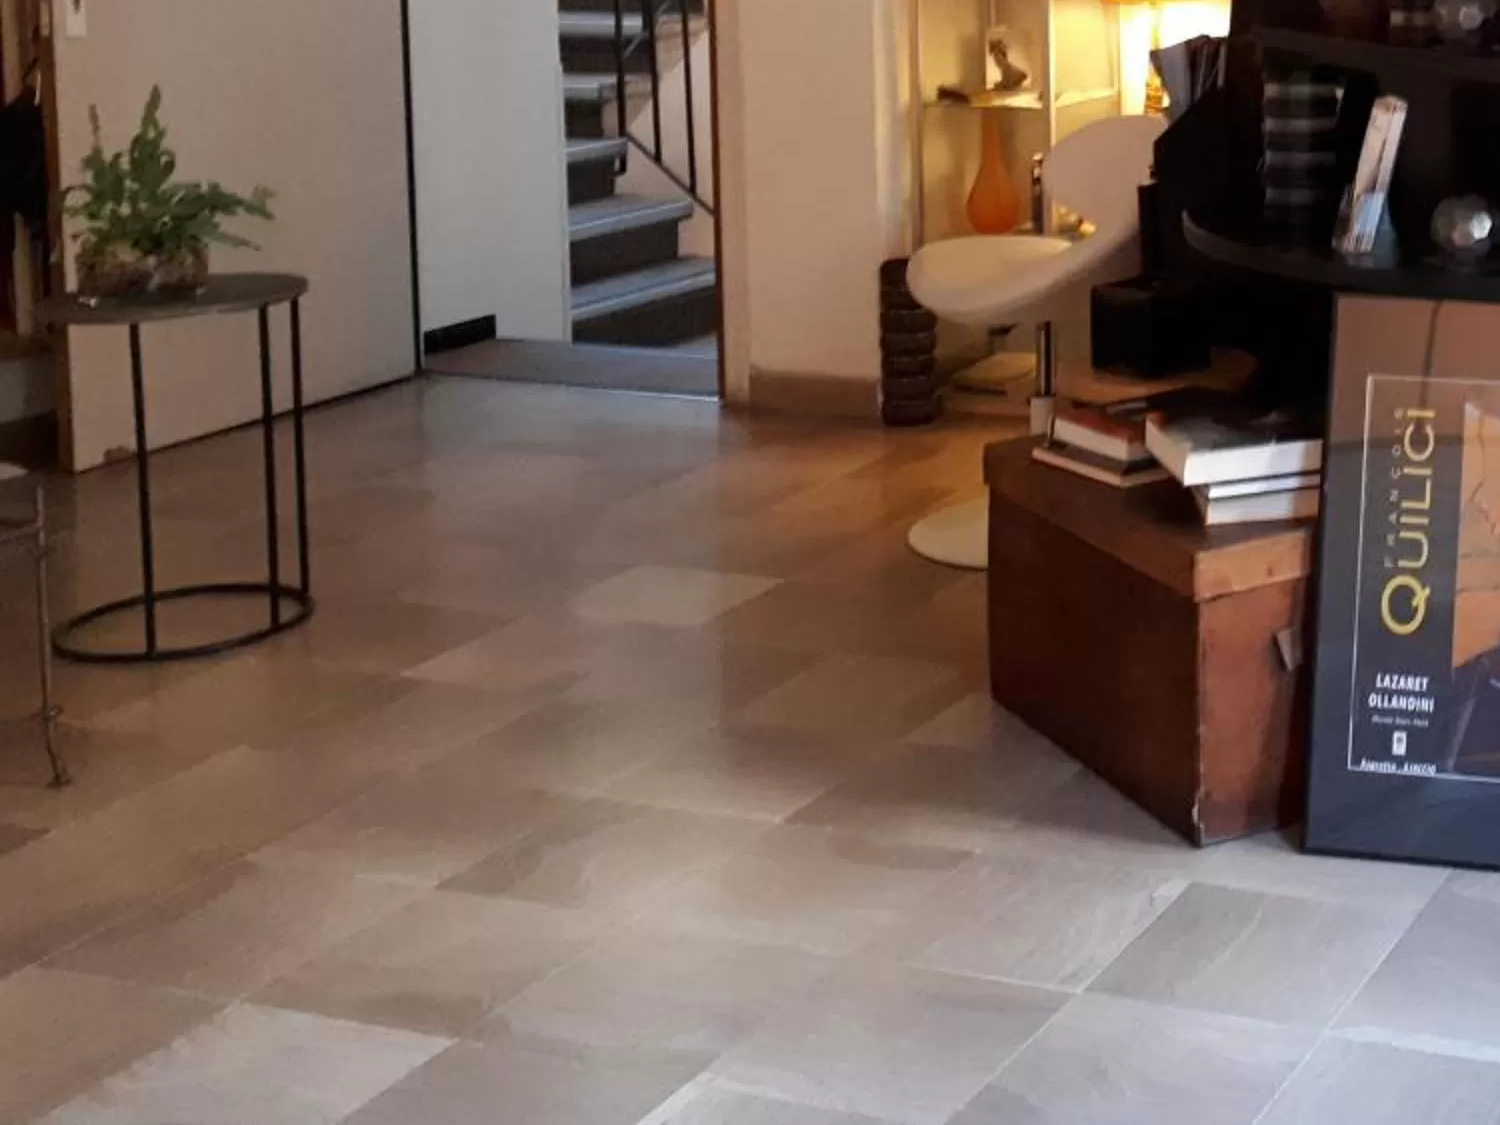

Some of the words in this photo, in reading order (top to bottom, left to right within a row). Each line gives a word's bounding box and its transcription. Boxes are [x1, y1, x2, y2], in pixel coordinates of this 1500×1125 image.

[1381, 408, 1436, 635] QUILICI
[1376, 672, 1429, 691] LAZARET
[1368, 692, 1435, 714] OLLANDINI
